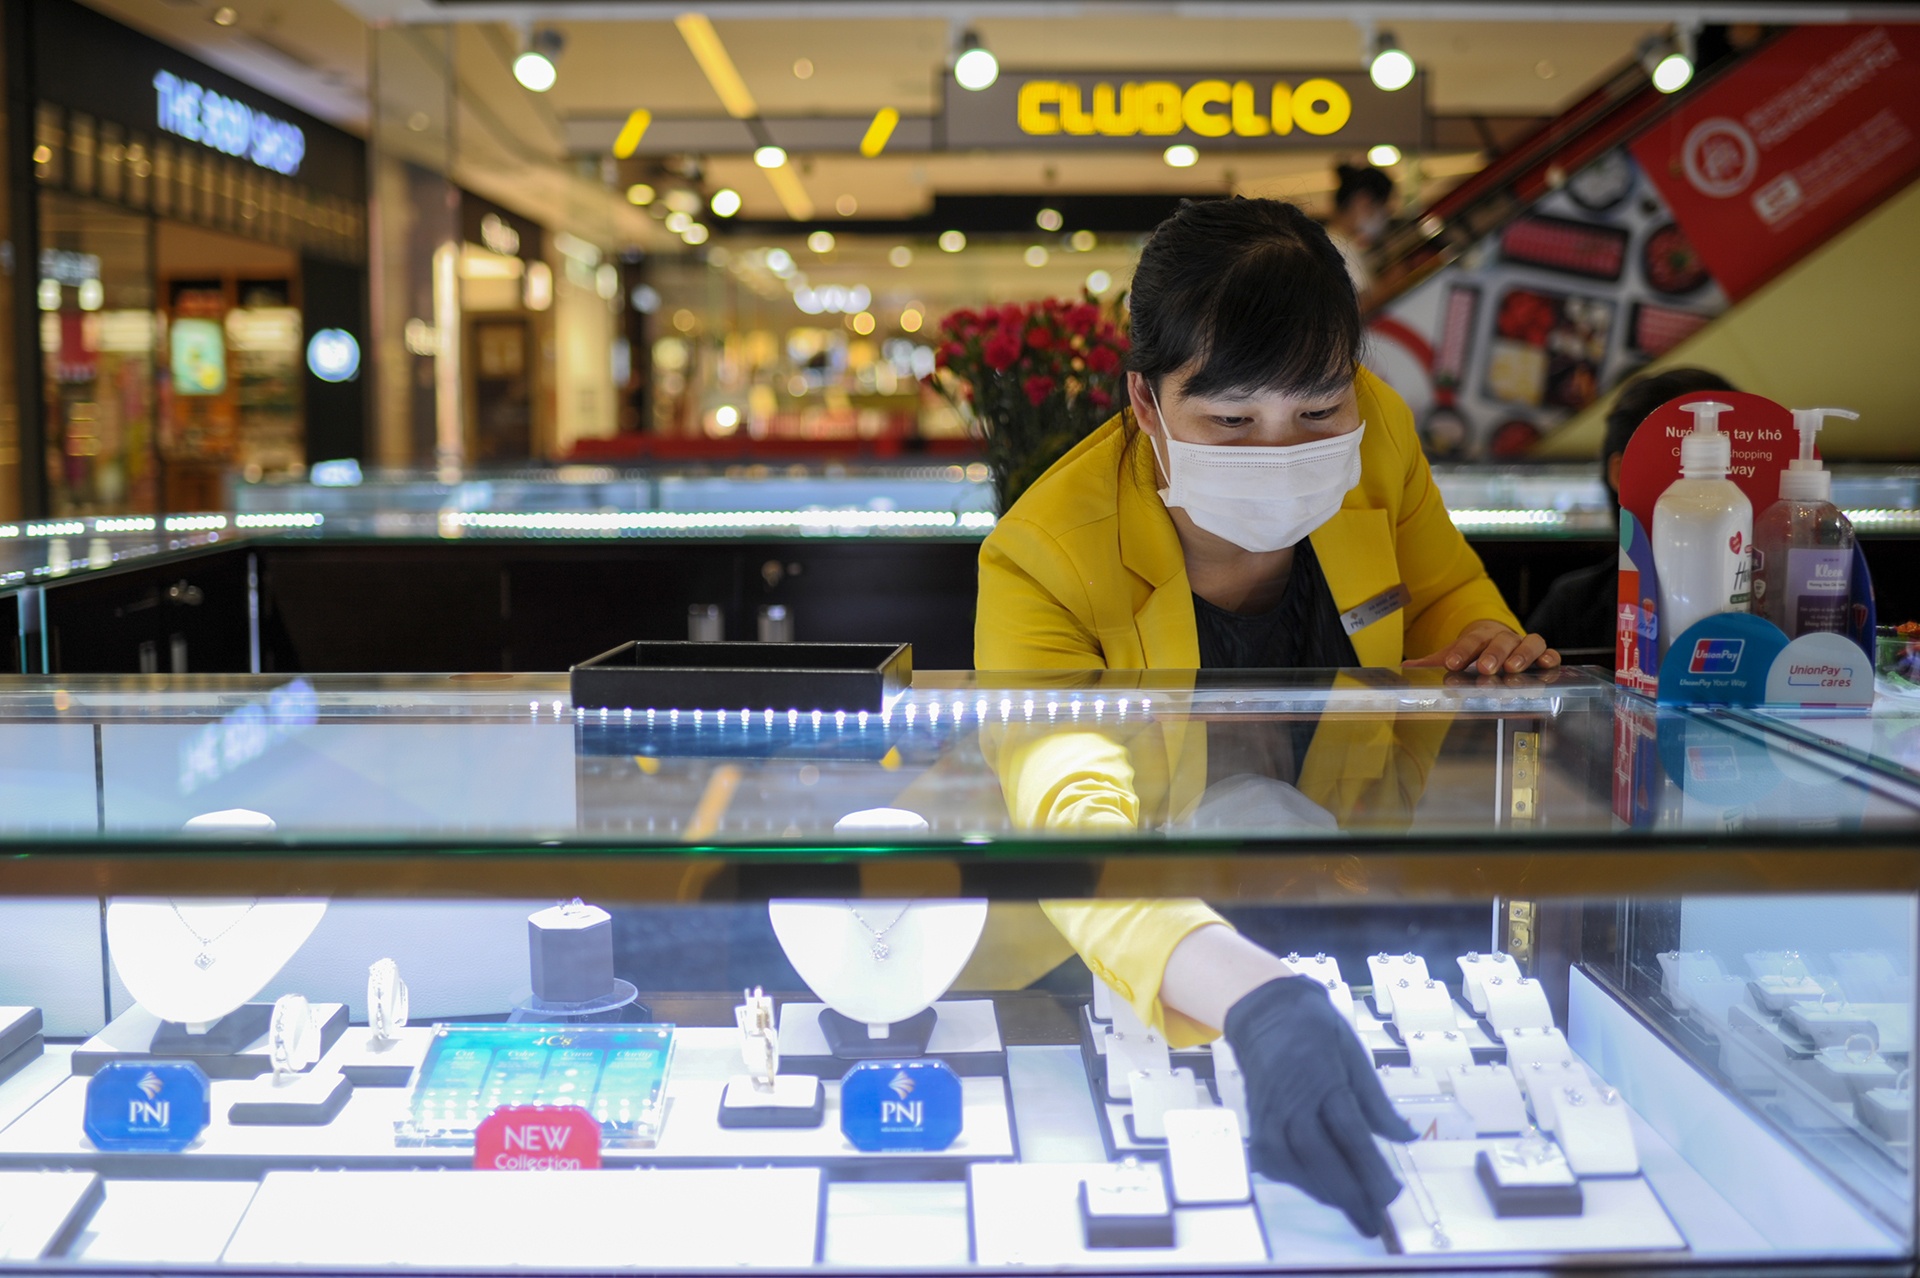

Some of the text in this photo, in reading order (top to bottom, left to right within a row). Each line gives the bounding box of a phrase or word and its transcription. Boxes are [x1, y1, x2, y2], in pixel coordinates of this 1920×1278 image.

[1734, 428, 1755, 443] tay
[1757, 428, 1783, 441] khô
[1730, 449, 1773, 461] hopping
[1695, 649, 1738, 663] UnionPay
[1789, 665, 1841, 677] UnionPay
[1679, 678, 1747, 688] UnionPay Your Way
[1820, 679, 1851, 687] cares
[129, 1101, 169, 1128] PNJ
[882, 1101, 922, 1128] PNJ
[504, 1125, 572, 1151] NEW
[495, 1153, 581, 1170] Collection
